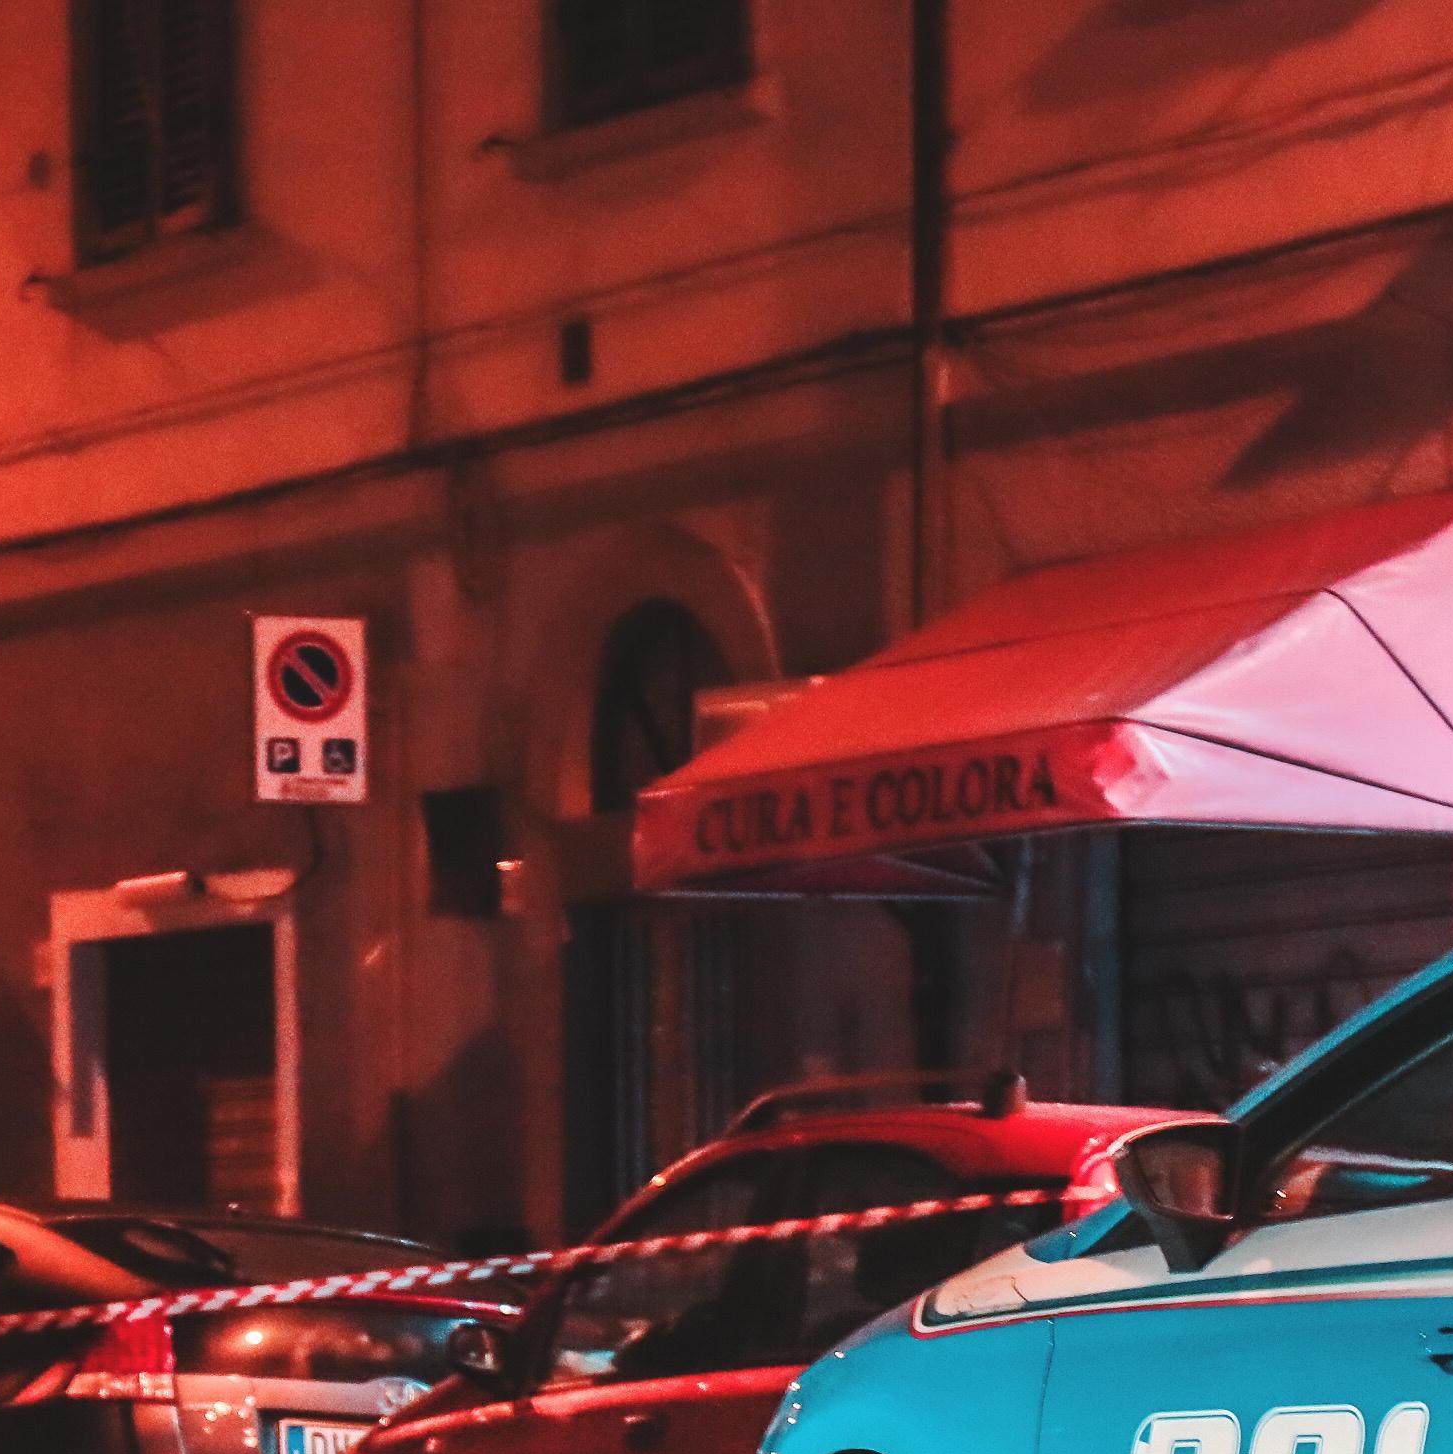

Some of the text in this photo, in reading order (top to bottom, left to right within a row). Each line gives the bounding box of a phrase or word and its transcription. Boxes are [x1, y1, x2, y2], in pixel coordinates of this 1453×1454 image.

[695, 750, 1058, 854] CURA E COLORA
